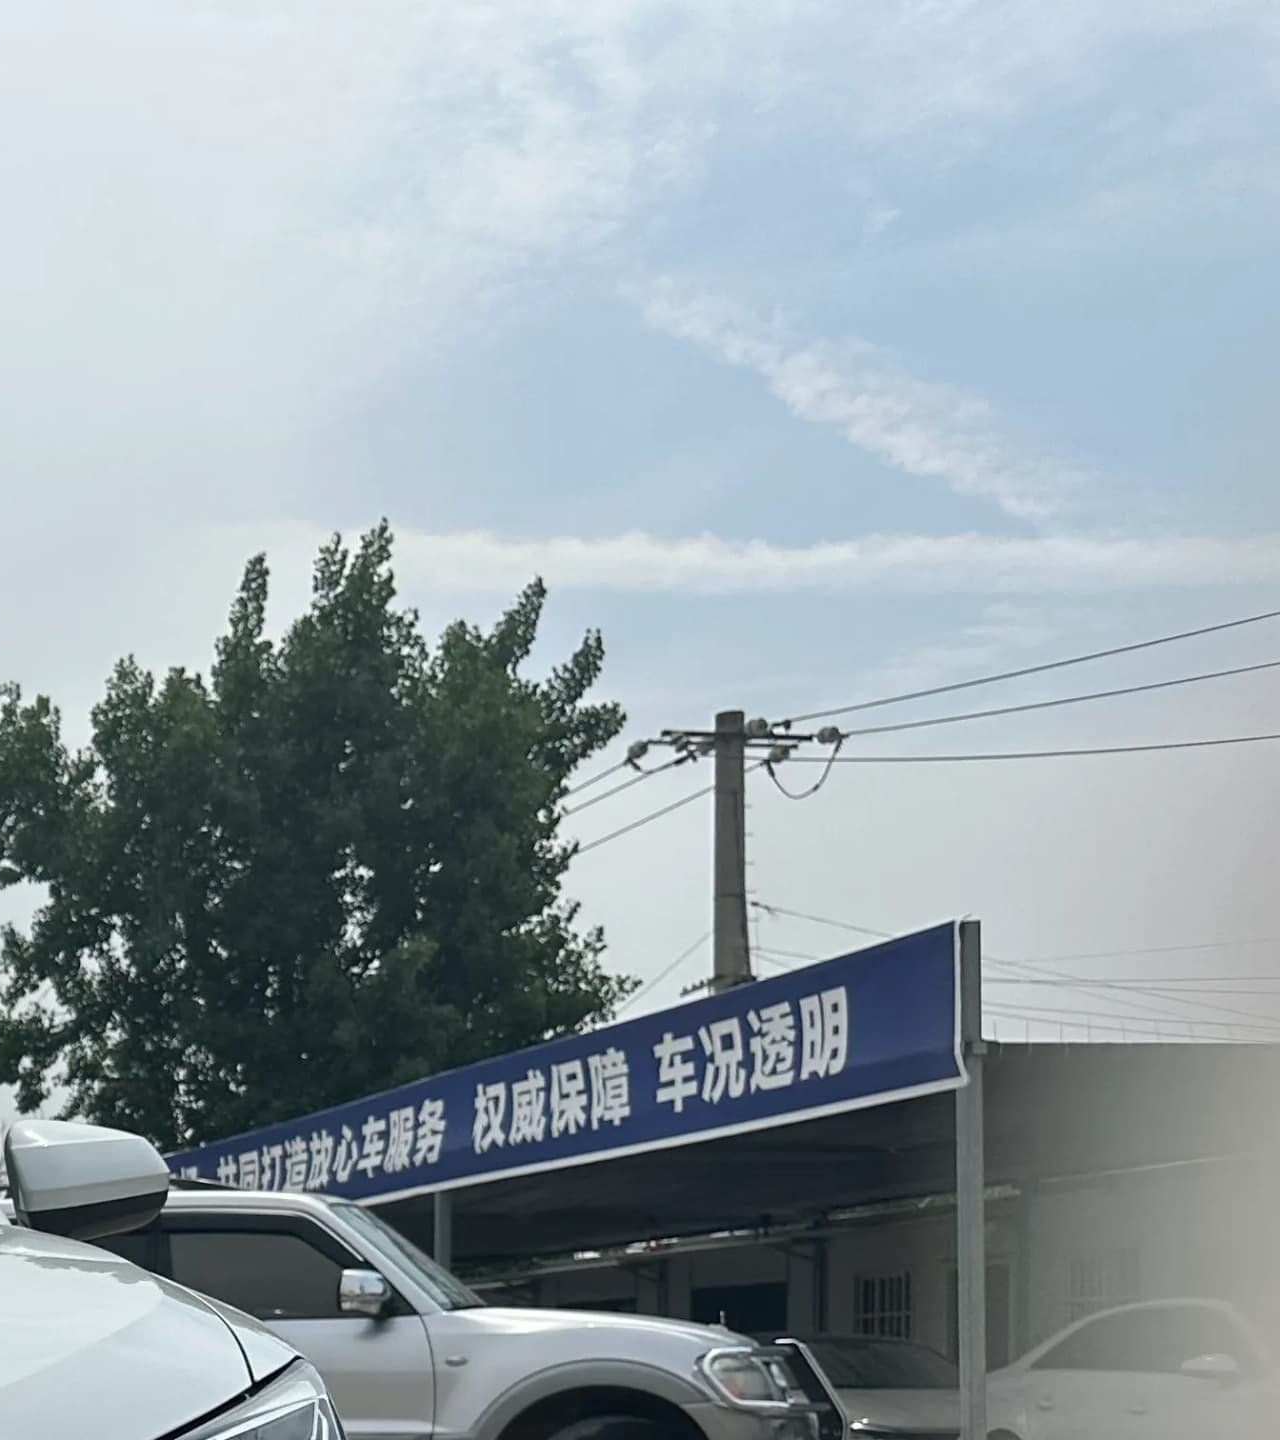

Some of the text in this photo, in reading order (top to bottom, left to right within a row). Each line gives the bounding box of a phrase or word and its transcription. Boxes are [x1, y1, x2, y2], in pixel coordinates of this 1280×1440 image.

[472, 1047, 630, 1154] 权威保障
[653, 986, 848, 1113] 车况透明
